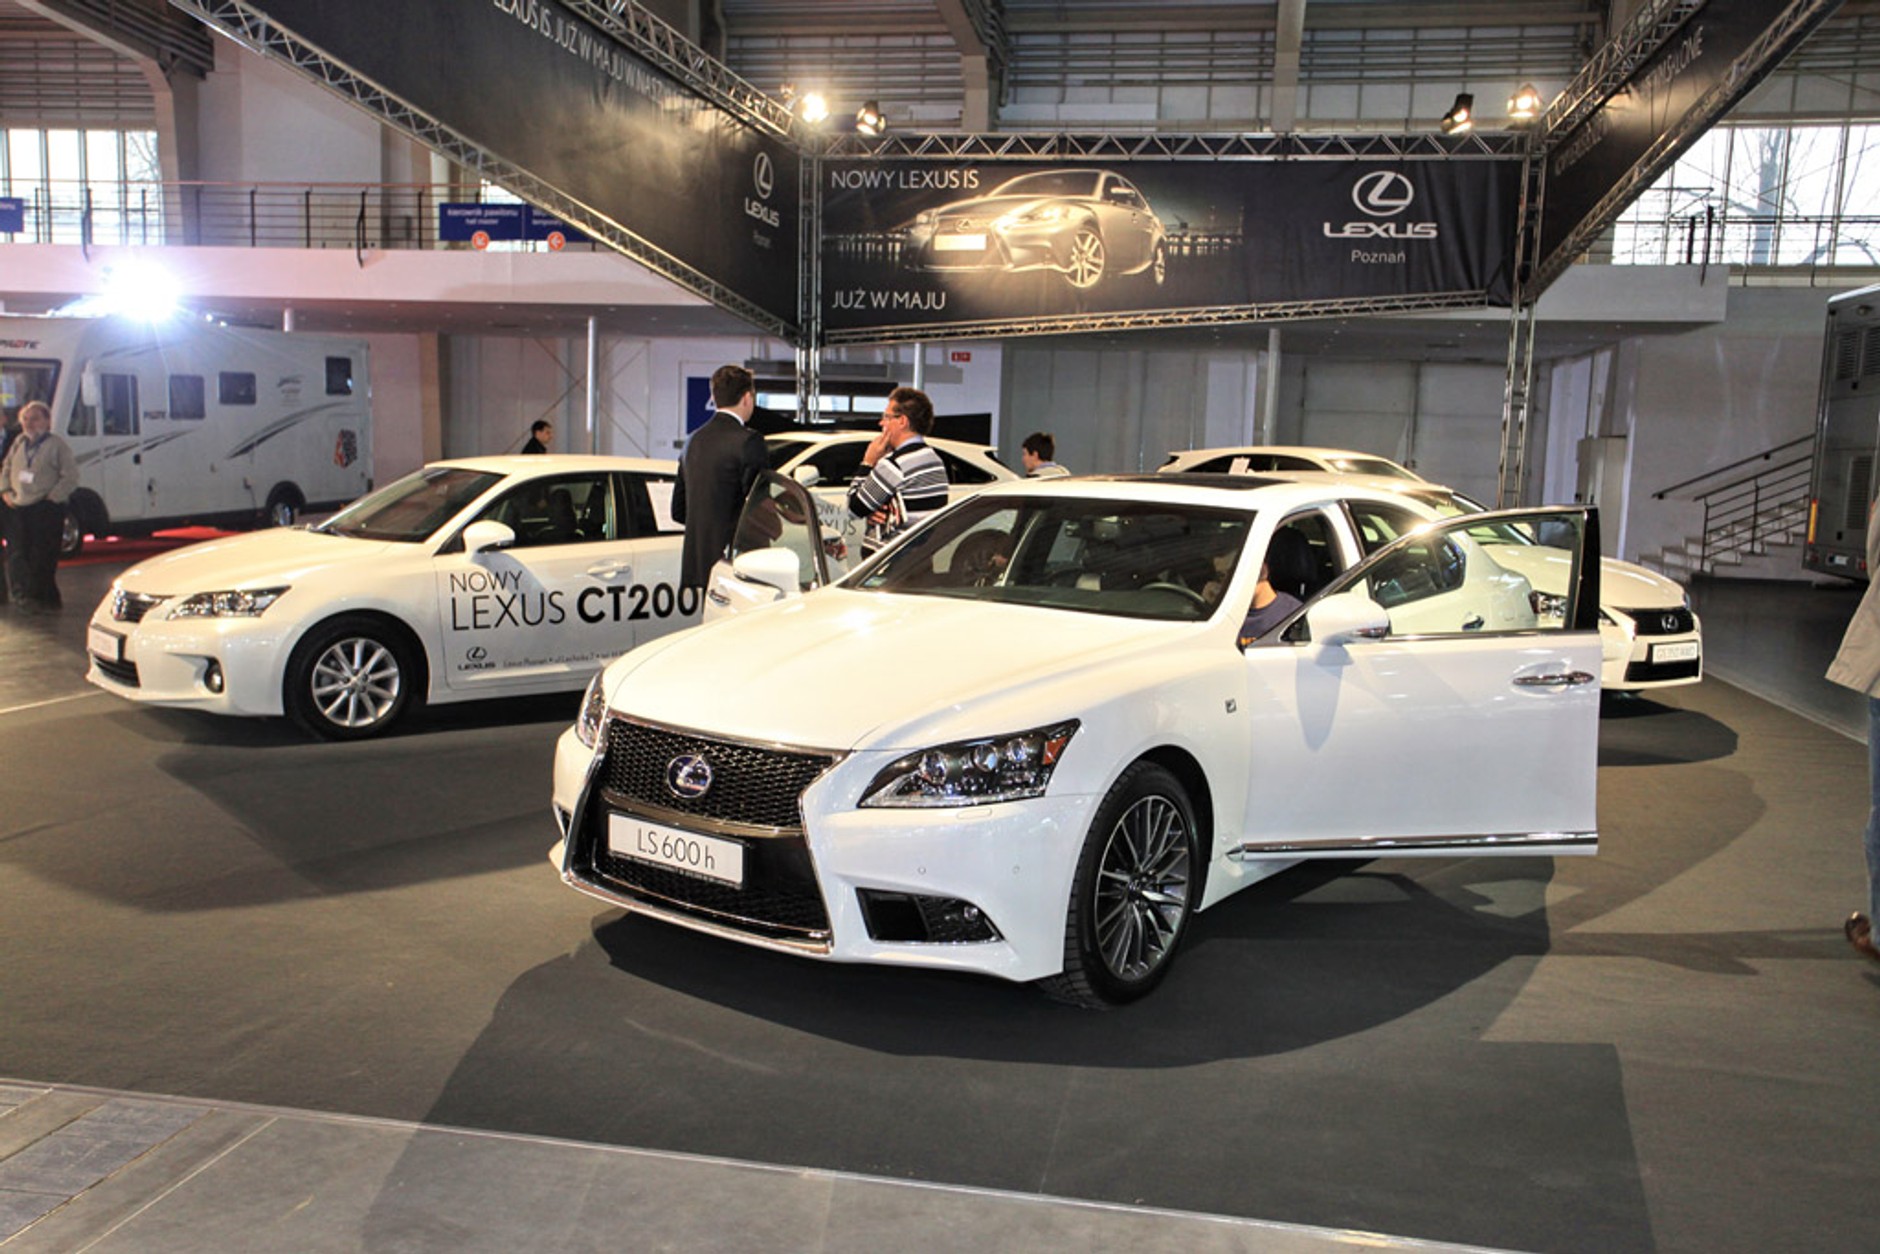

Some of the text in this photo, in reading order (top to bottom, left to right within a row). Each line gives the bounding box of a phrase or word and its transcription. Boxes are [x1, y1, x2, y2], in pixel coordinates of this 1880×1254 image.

[579, 32, 593, 61] W
[593, 43, 625, 80] MAJU
[831, 170, 980, 189] NOWY LEXUS IS
[1323, 221, 1439, 239] LEXUS
[1351, 249, 1407, 264] Poznań
[831, 286, 947, 310] JUŻ W MAJU
[450, 570, 523, 593] NOWY
[451, 582, 705, 632] LEXUS CT200
[637, 828, 716, 870] LS 600 h
